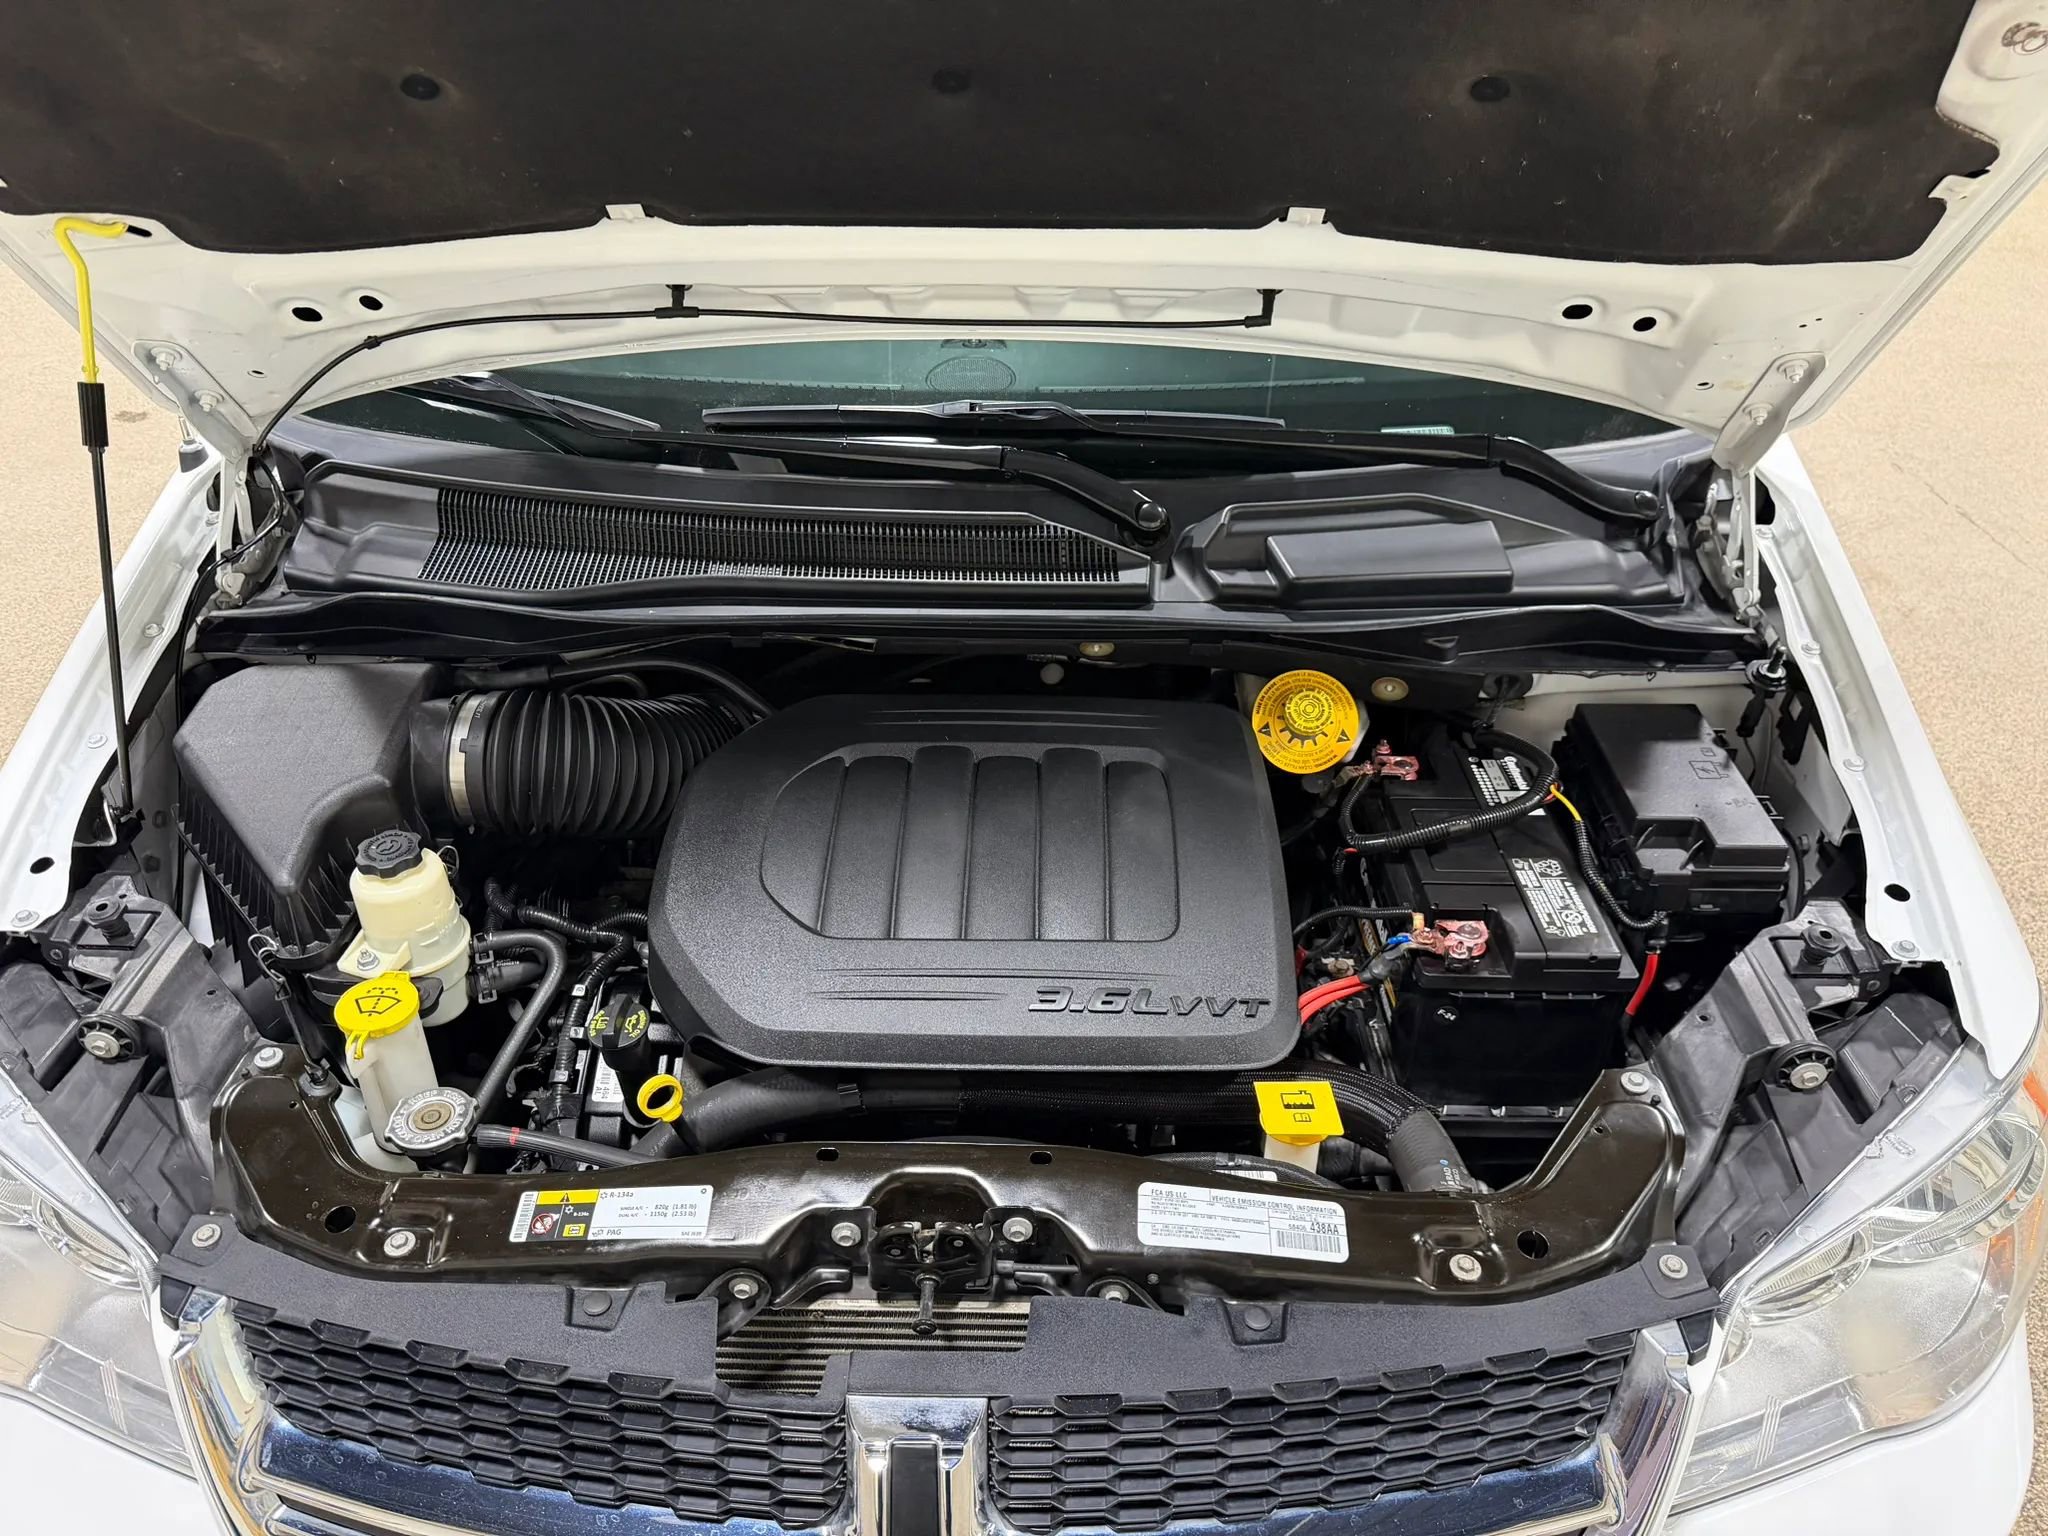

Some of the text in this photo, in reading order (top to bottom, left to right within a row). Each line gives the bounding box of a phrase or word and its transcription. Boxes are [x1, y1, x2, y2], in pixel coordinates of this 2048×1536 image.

[1170, 996, 1271, 1017] VVT
[1212, 1195, 1235, 1204] VEHICLE
[1237, 1198, 1266, 1207] EMISSION
[1268, 1202, 1294, 1211] CONTROL
[1296, 1205, 1338, 1215] INFORMATION
[606, 1228, 622, 1236] PAG
[1310, 1222, 1339, 1235] 438AA
